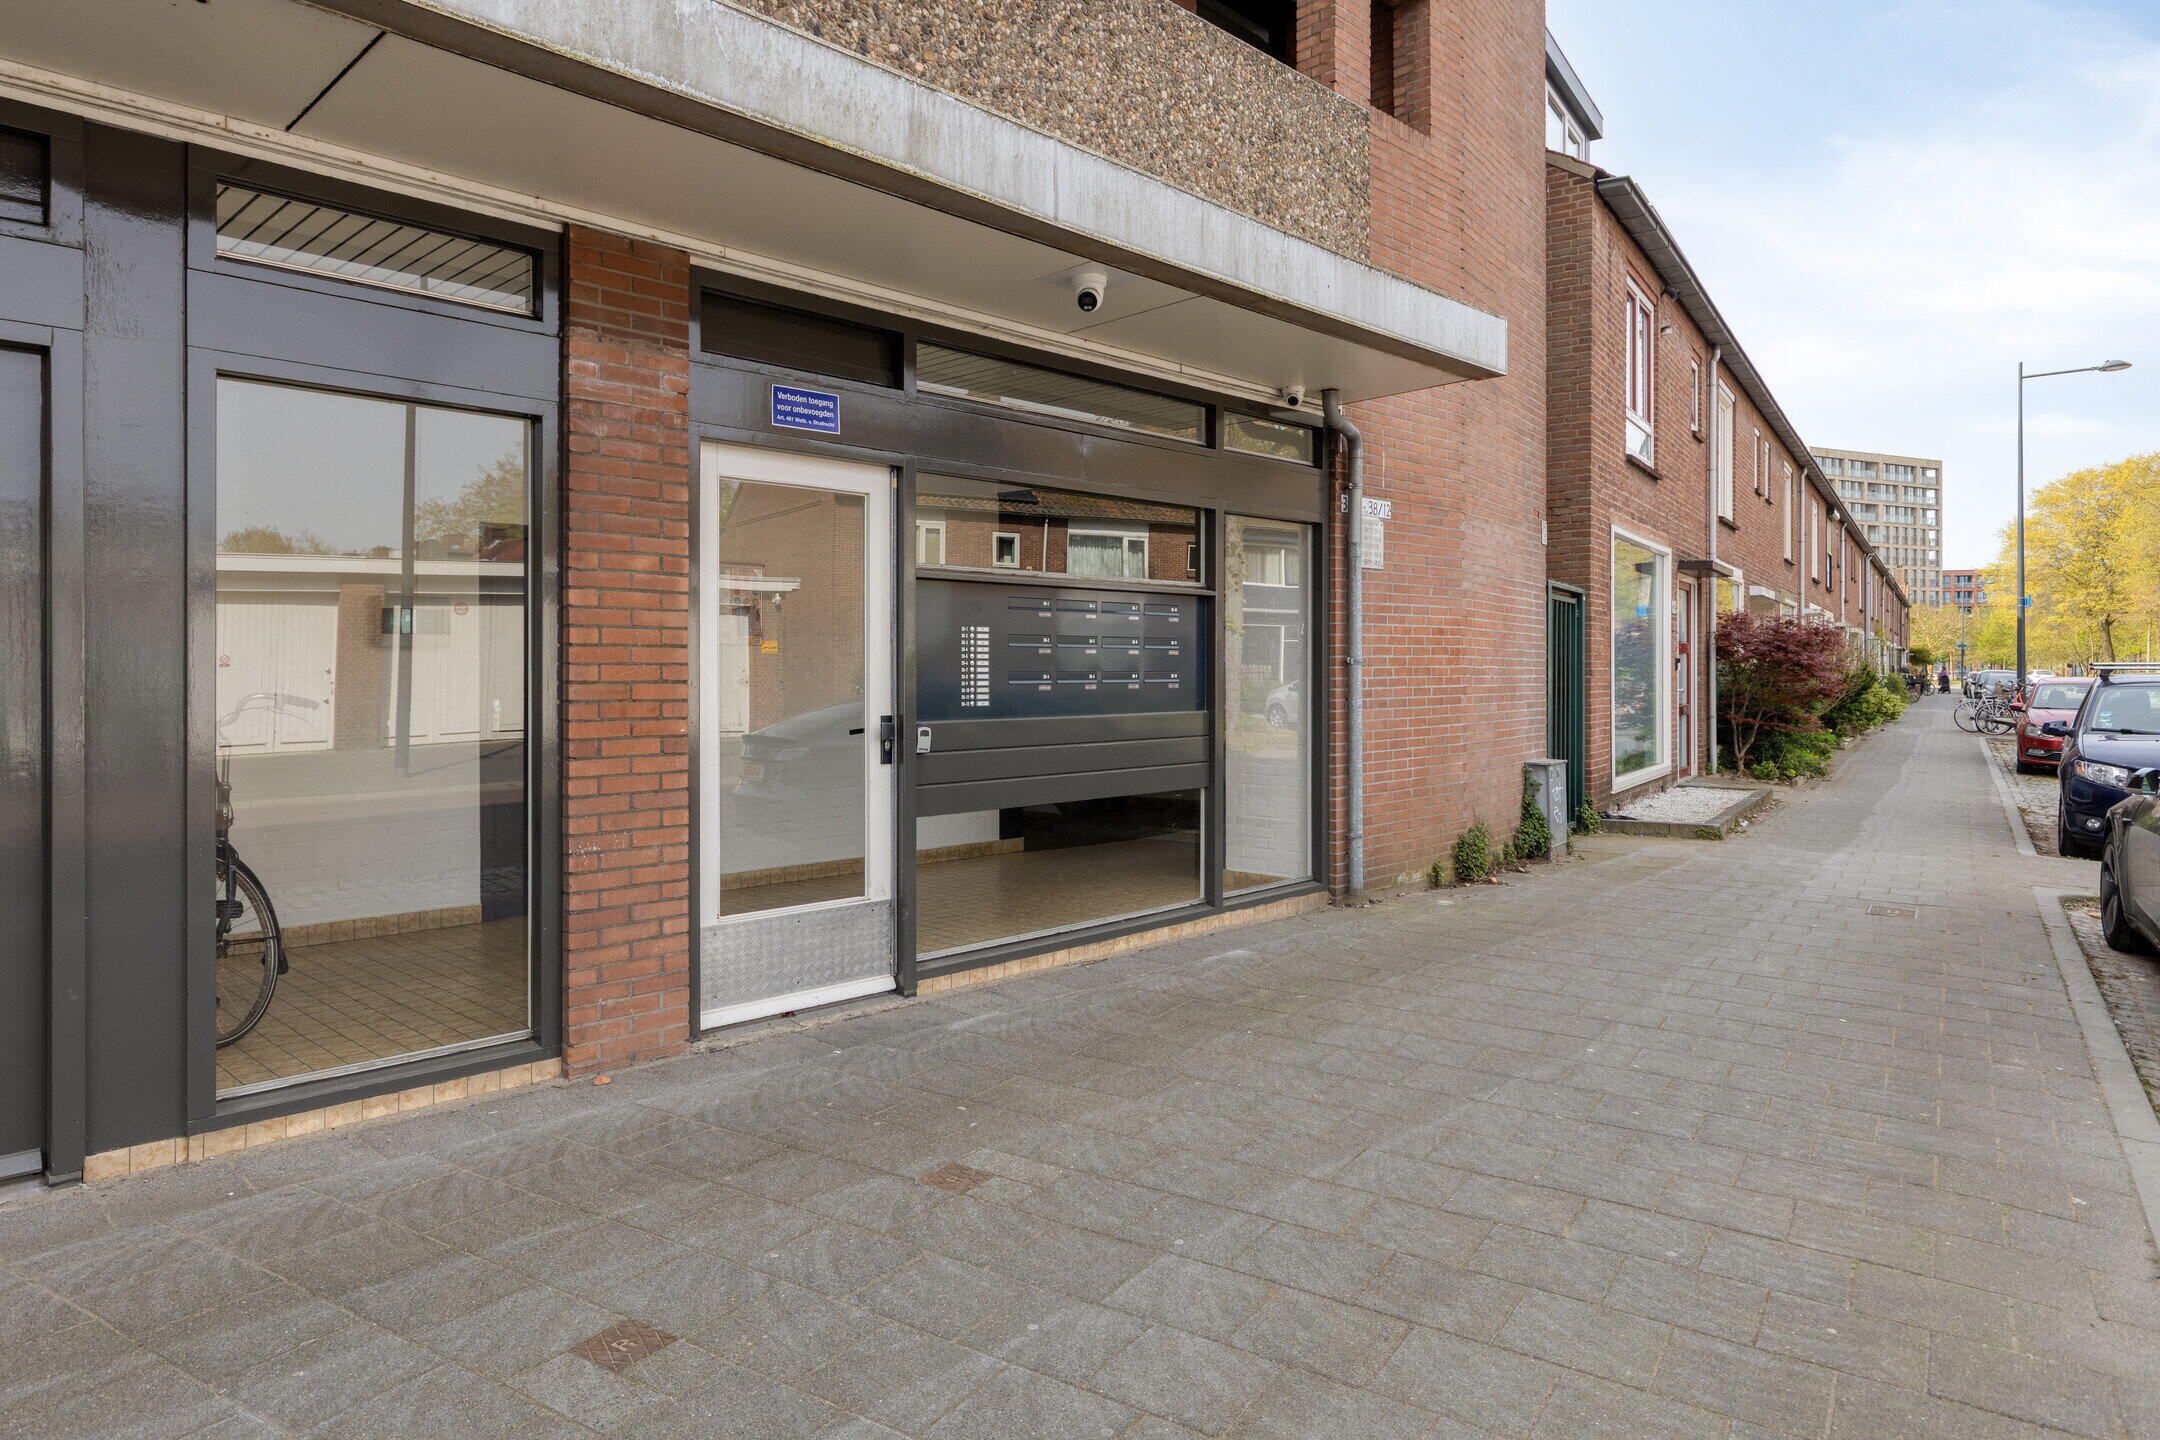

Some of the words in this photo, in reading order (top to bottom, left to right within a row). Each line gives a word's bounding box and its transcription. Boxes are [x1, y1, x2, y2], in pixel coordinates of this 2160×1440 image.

[777, 391, 807, 403] Verboden
[809, 397, 833, 409] toegang
[777, 404, 792, 412] voor
[793, 406, 834, 418] onbevoegden
[610, 1339, 636, 1351] R
